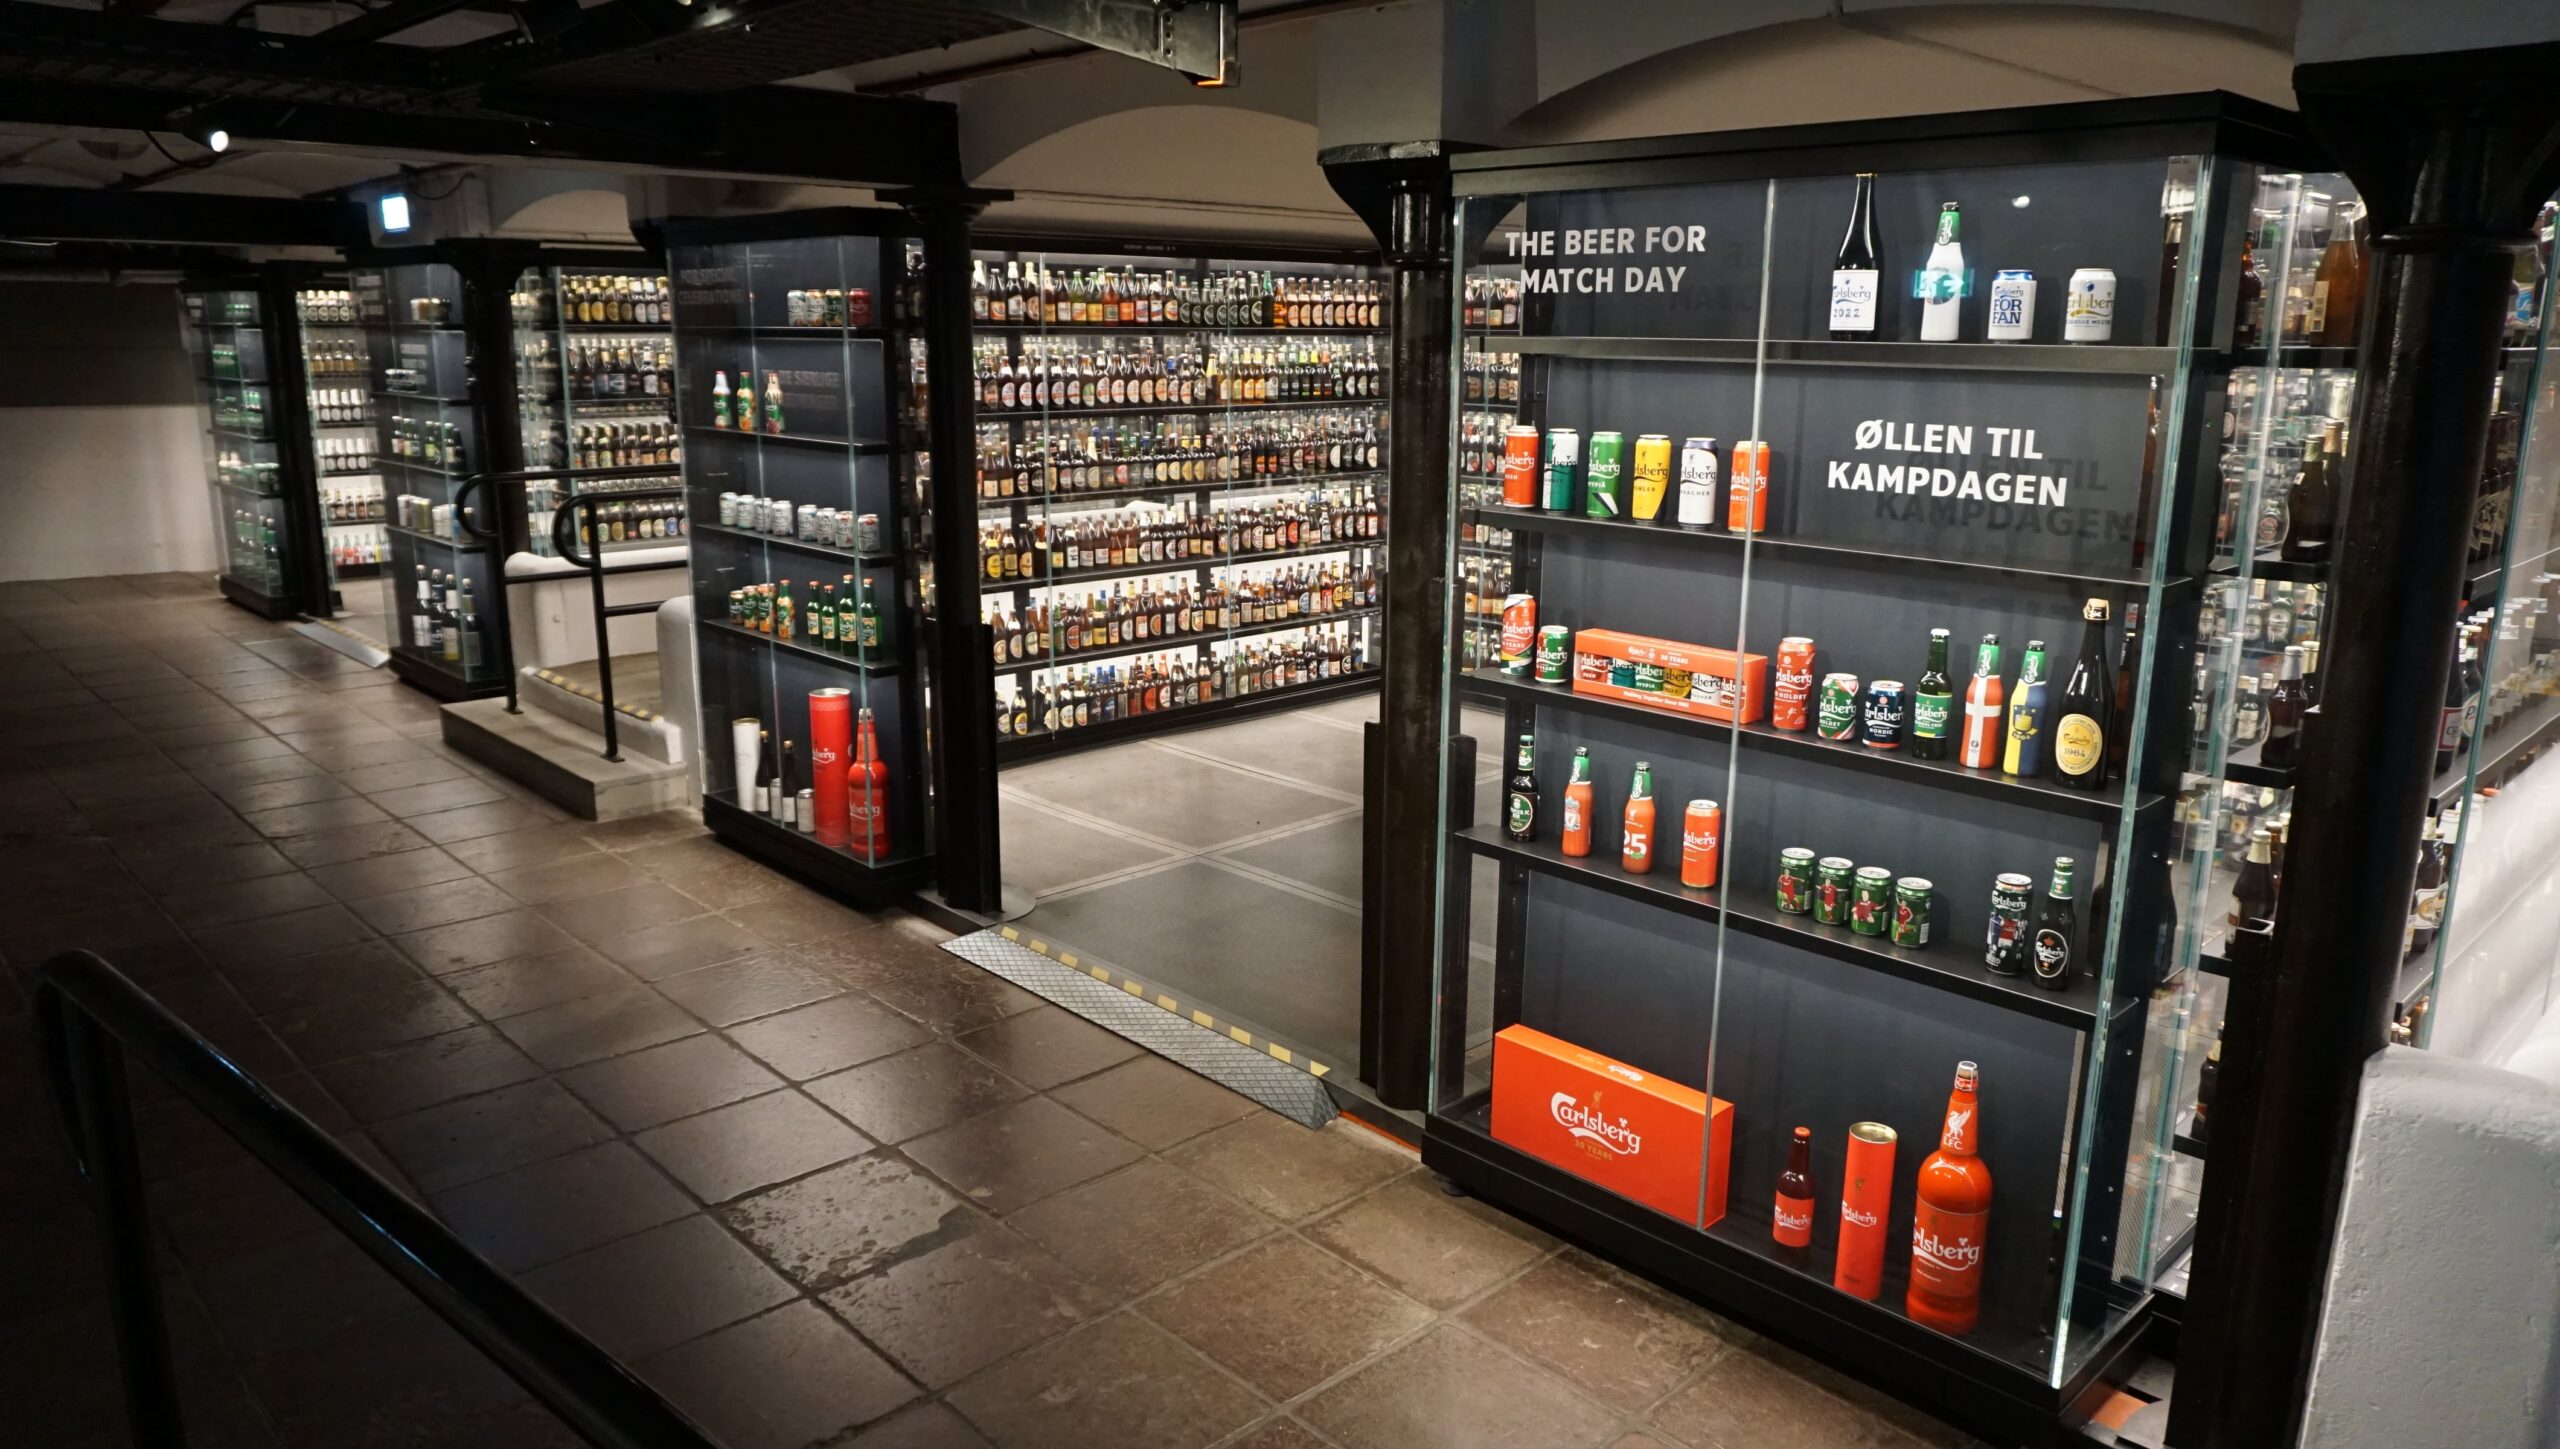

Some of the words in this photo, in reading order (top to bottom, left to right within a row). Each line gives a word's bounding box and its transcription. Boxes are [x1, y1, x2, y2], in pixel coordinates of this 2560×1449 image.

[1504, 230, 1555, 257] THE
[1564, 228, 1635, 255] BEER
[1645, 225, 1707, 253] FOR
[1520, 266, 1614, 294] MATCH
[1625, 265, 1687, 293] DAY
[1833, 285, 1871, 303] arlsberg
[1993, 298, 2022, 312] FOR
[1992, 311, 2022, 325] FAN
[1855, 419, 1973, 455] ØLLEN
[1987, 427, 2043, 460] TIL
[1827, 461, 2068, 507] KAMPDAGEN
[1669, 655, 1689, 664] YEARS
[1869, 727, 1893, 735] NORDIC
[1992, 889, 2027, 909] Carlsberg
[2036, 941, 2065, 959] Carlsberg
[1551, 1091, 1641, 1155] Carlsberg
[1943, 1135, 1963, 1150] LFC
[1586, 1143, 1613, 1161] YEARS
